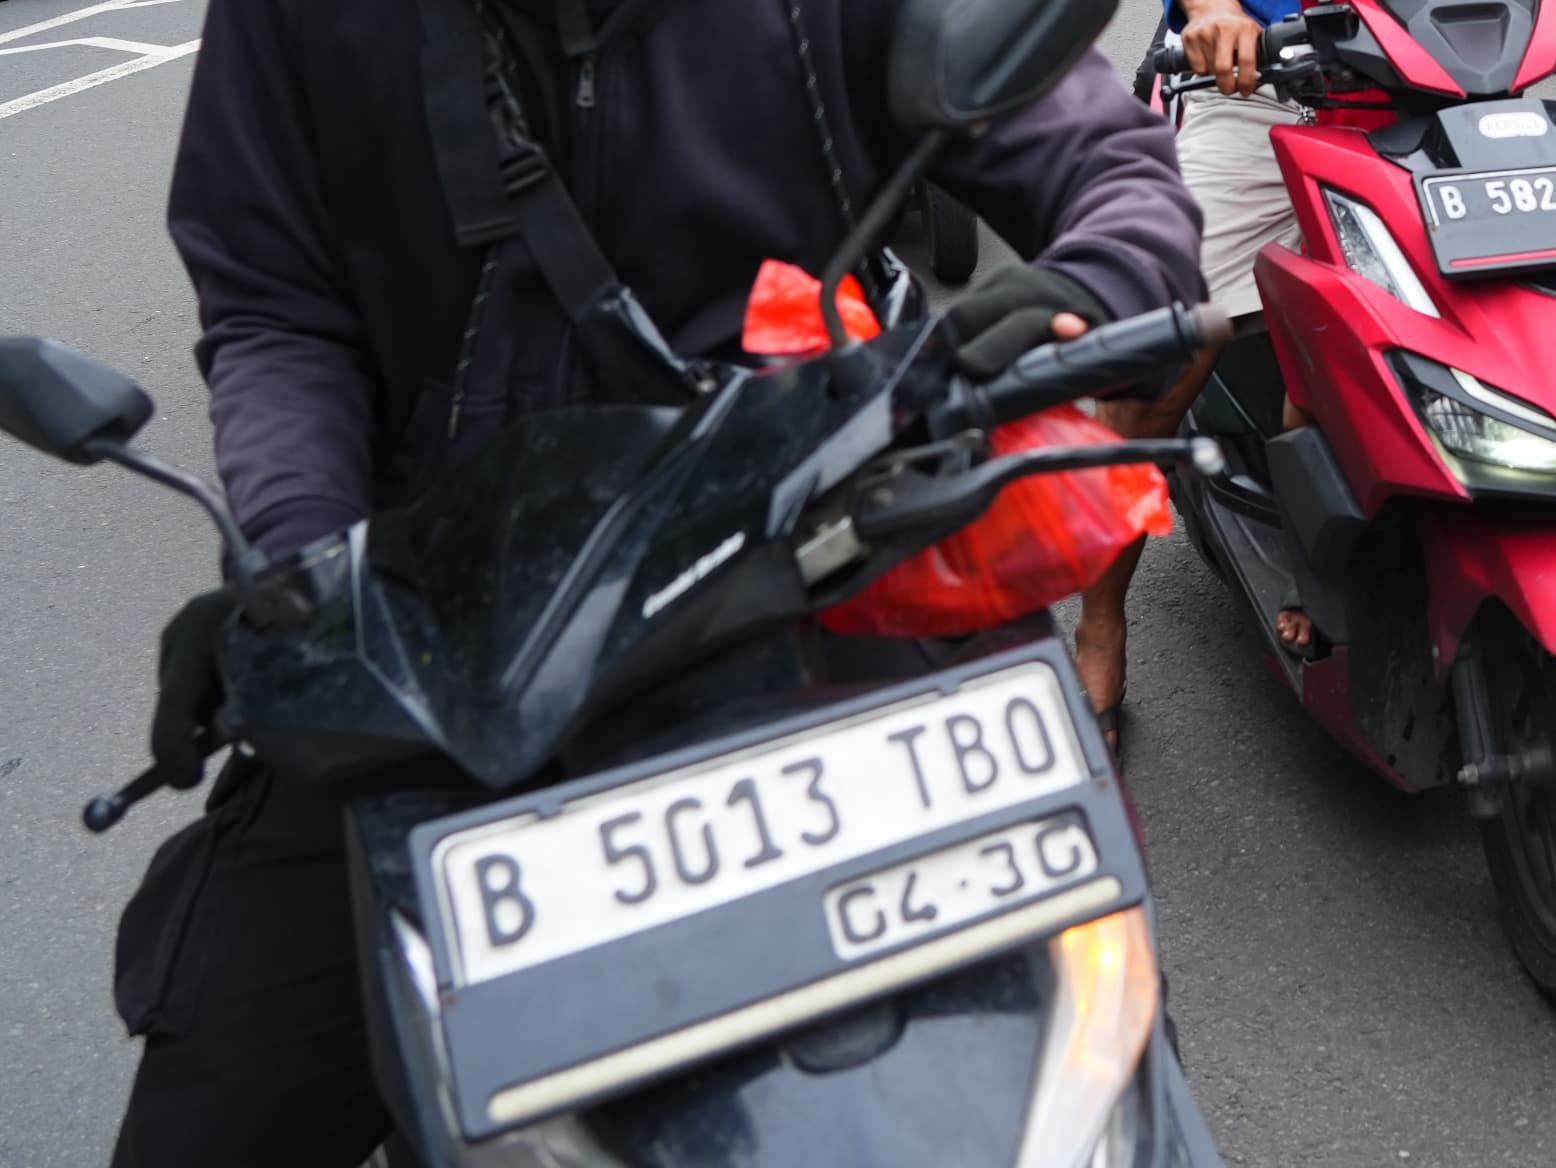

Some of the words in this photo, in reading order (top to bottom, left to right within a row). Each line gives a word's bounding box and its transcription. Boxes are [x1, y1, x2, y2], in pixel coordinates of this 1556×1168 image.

[1439, 185, 1466, 220] B
[474, 852, 535, 947] B
[599, 757, 841, 905] 5013
